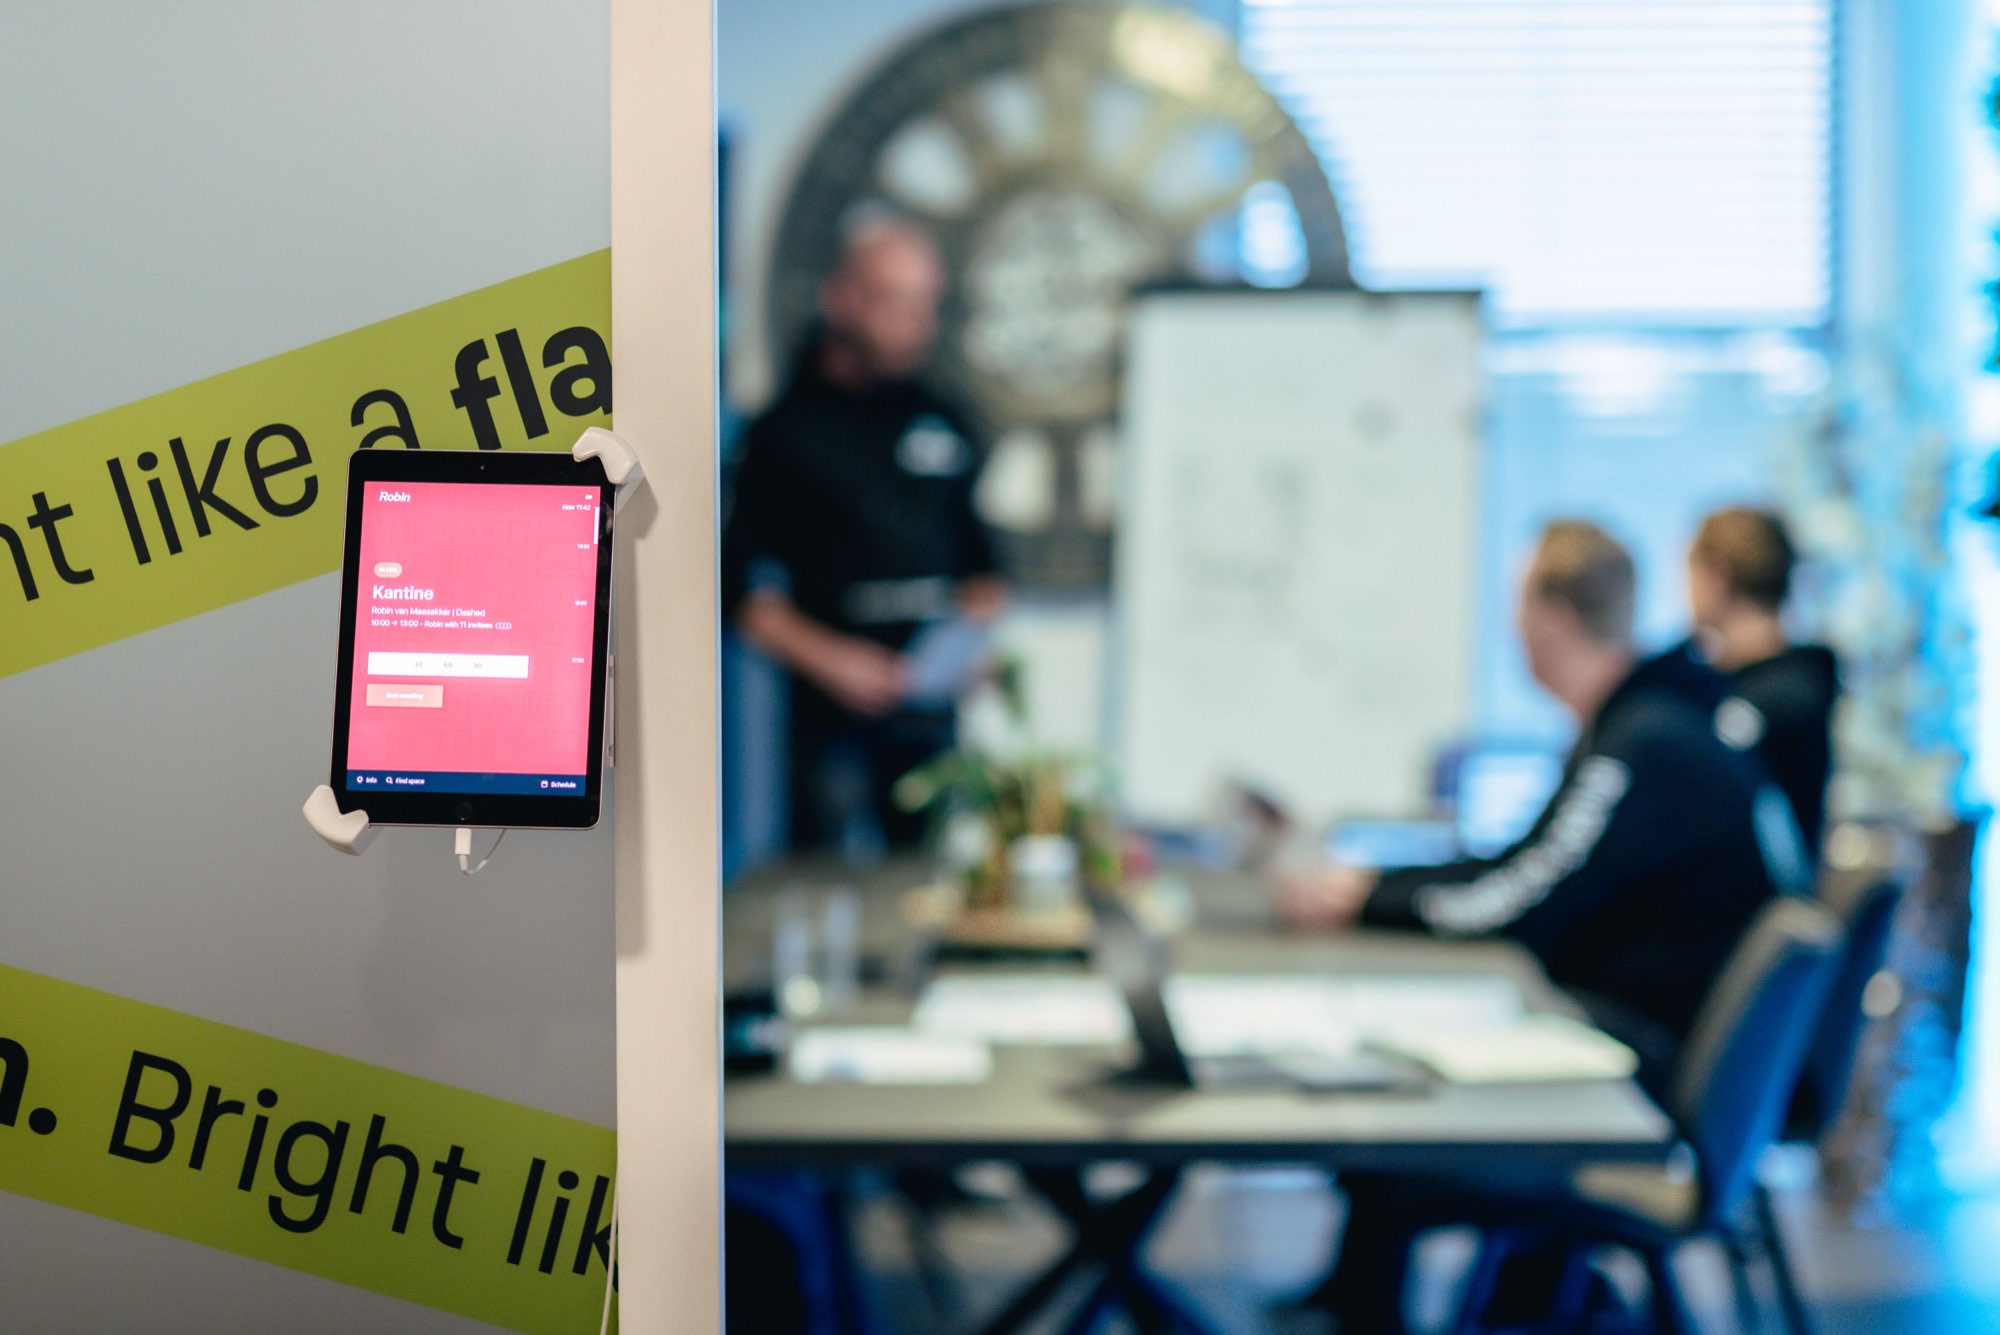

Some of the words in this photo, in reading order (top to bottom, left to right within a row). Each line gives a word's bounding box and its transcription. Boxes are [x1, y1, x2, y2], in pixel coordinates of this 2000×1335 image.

[106, 423, 319, 566] like
[350, 389, 421, 450] a
[379, 491, 411, 502] Robin
[372, 585, 434, 600] Kantine
[371, 606, 394, 615] Robin
[456, 608, 486, 617] Dashed
[424, 620, 444, 628] Robin
[395, 777, 408, 785] Find
[550, 781, 577, 789] Schedule
[107, 1049, 481, 1251] Bright
